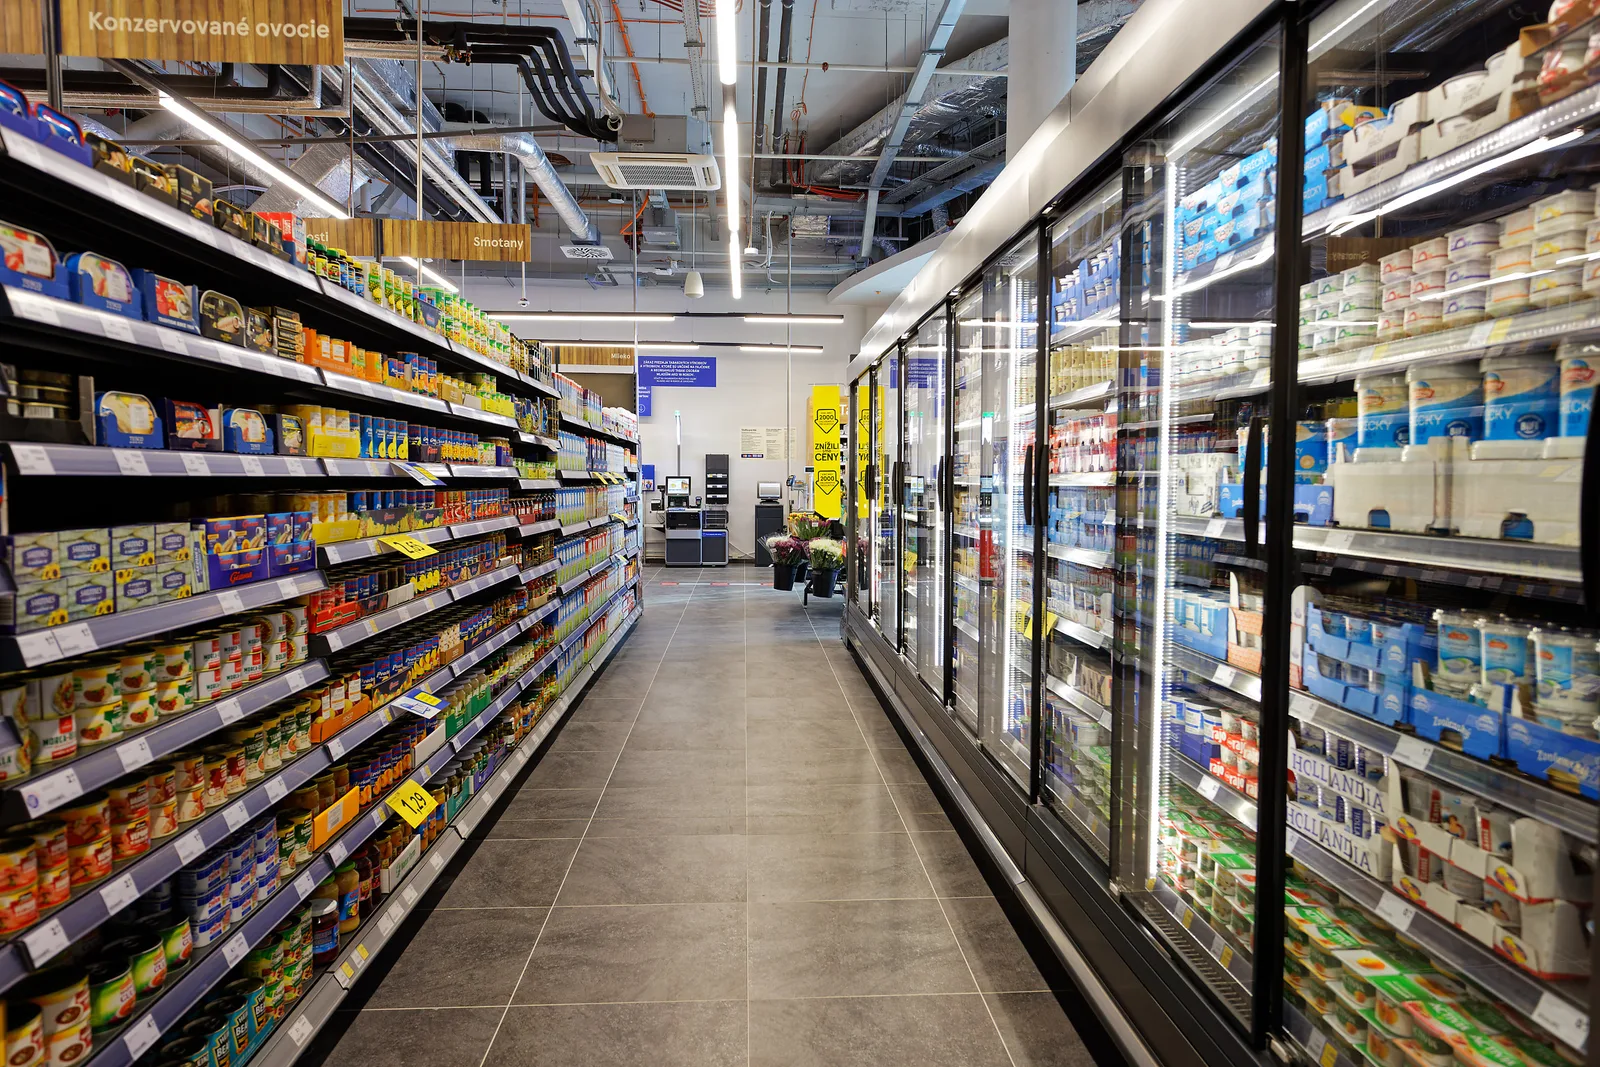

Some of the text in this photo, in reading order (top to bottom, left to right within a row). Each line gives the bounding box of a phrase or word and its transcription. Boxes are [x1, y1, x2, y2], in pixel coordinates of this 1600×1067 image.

[88, 11, 330, 39] Konzervované ovocie
[473, 236, 524, 250] Smotany
[815, 442, 839, 450] ZNÍŽILI
[815, 453, 838, 461] CENY
[1212, 728, 1226, 743] rajo
[1210, 761, 1224, 776] rajo
[1292, 753, 1384, 812] HOLLANDIA
[400, 792, 427, 815] 1,29
[1287, 808, 1371, 872] HOLLANDIA
